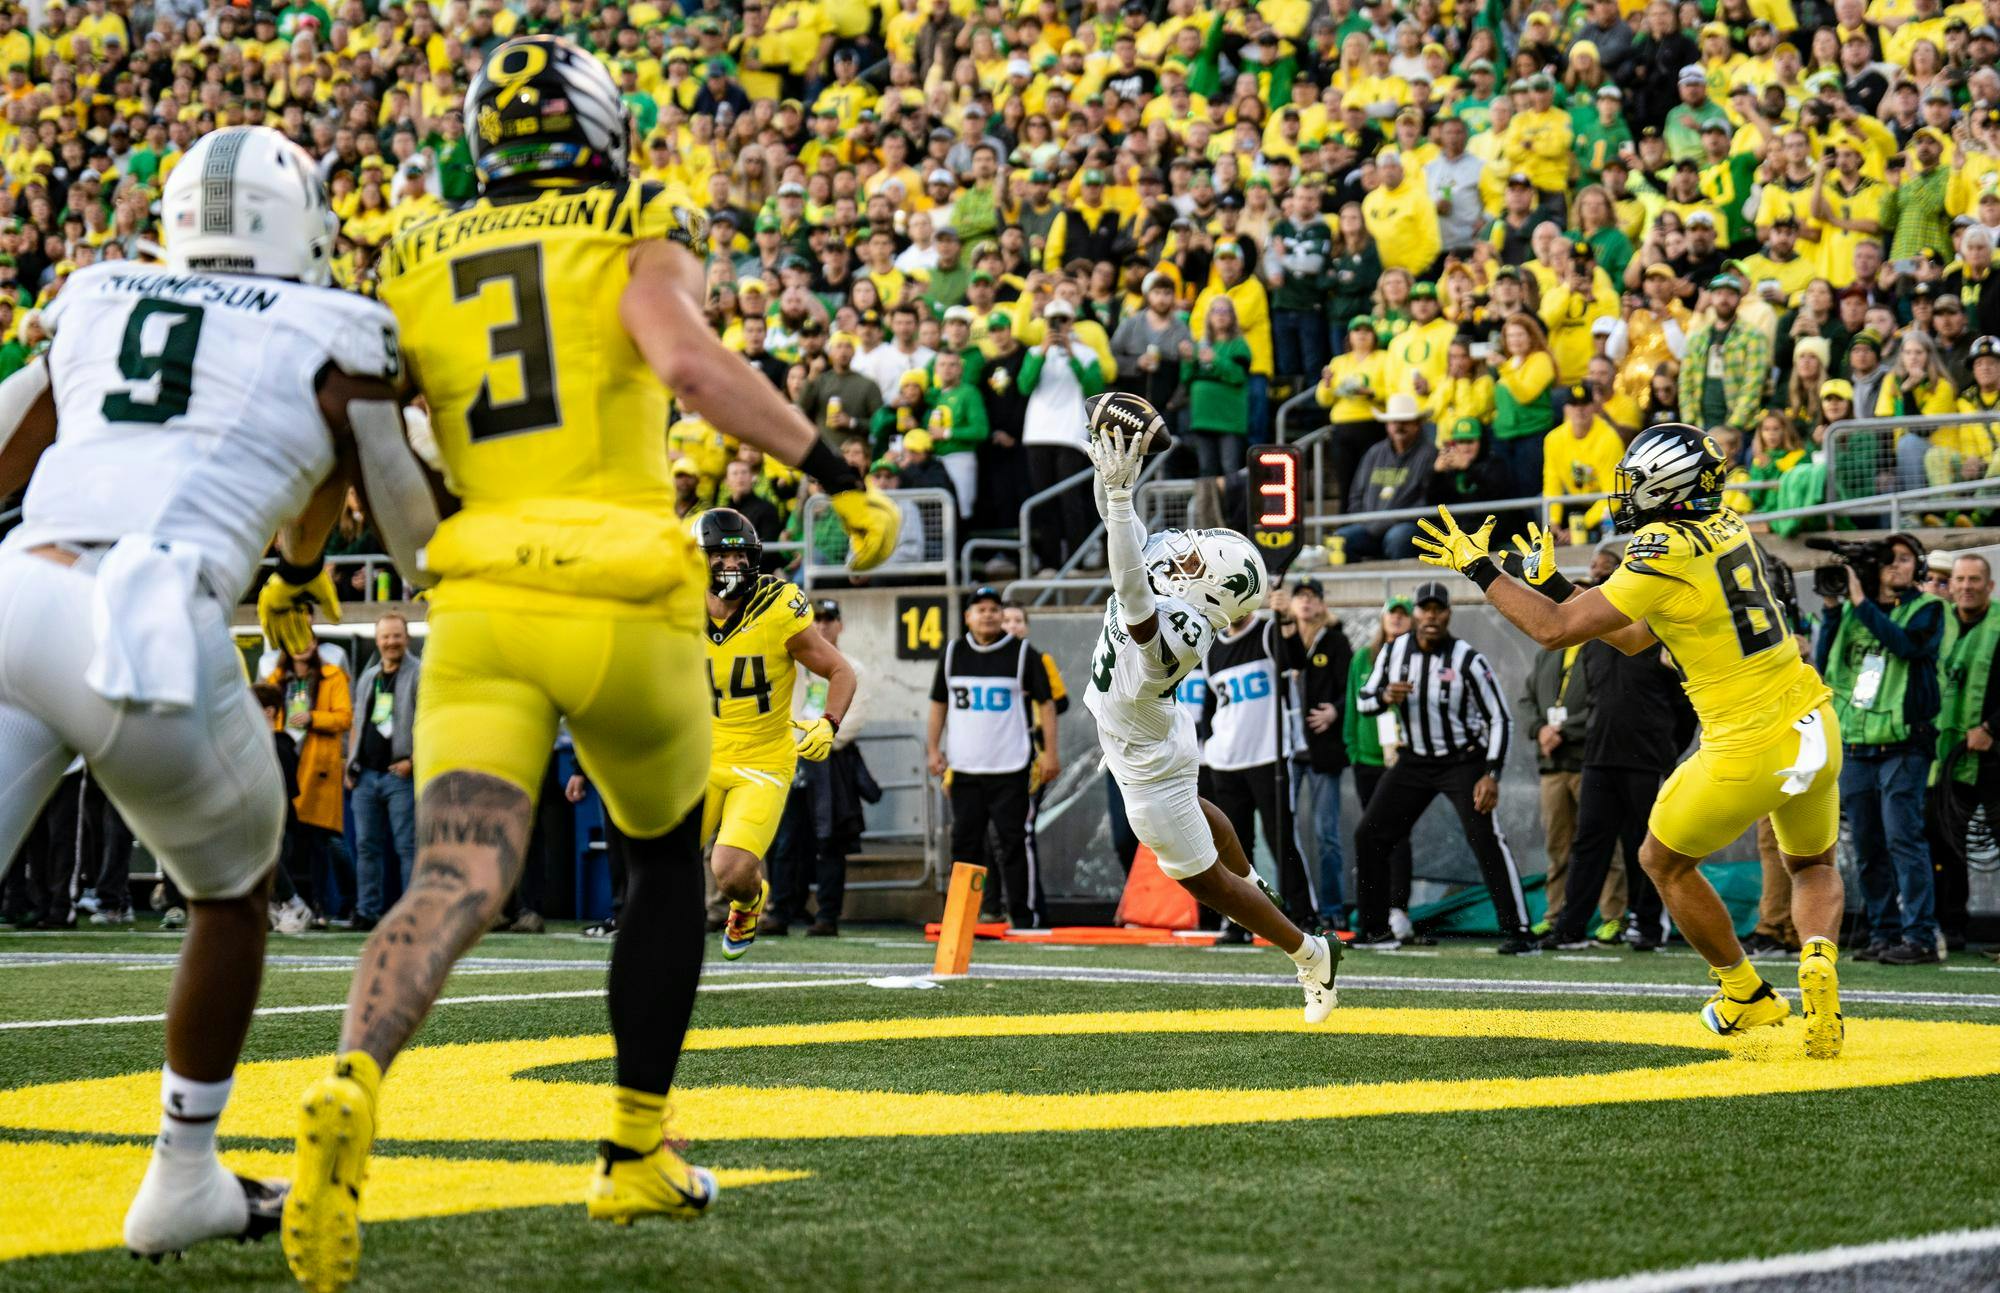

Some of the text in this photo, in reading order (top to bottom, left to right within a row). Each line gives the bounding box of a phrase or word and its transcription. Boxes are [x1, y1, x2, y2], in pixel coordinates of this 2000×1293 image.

[414, 197, 600, 263] FERGUSON
[100, 297, 205, 424] 9
[450, 240, 564, 444] 3
[1260, 453, 1295, 526] 3
[902, 606, 943, 650] 14
[1168, 610, 1202, 648] 43
[1715, 540, 1792, 660] 8
